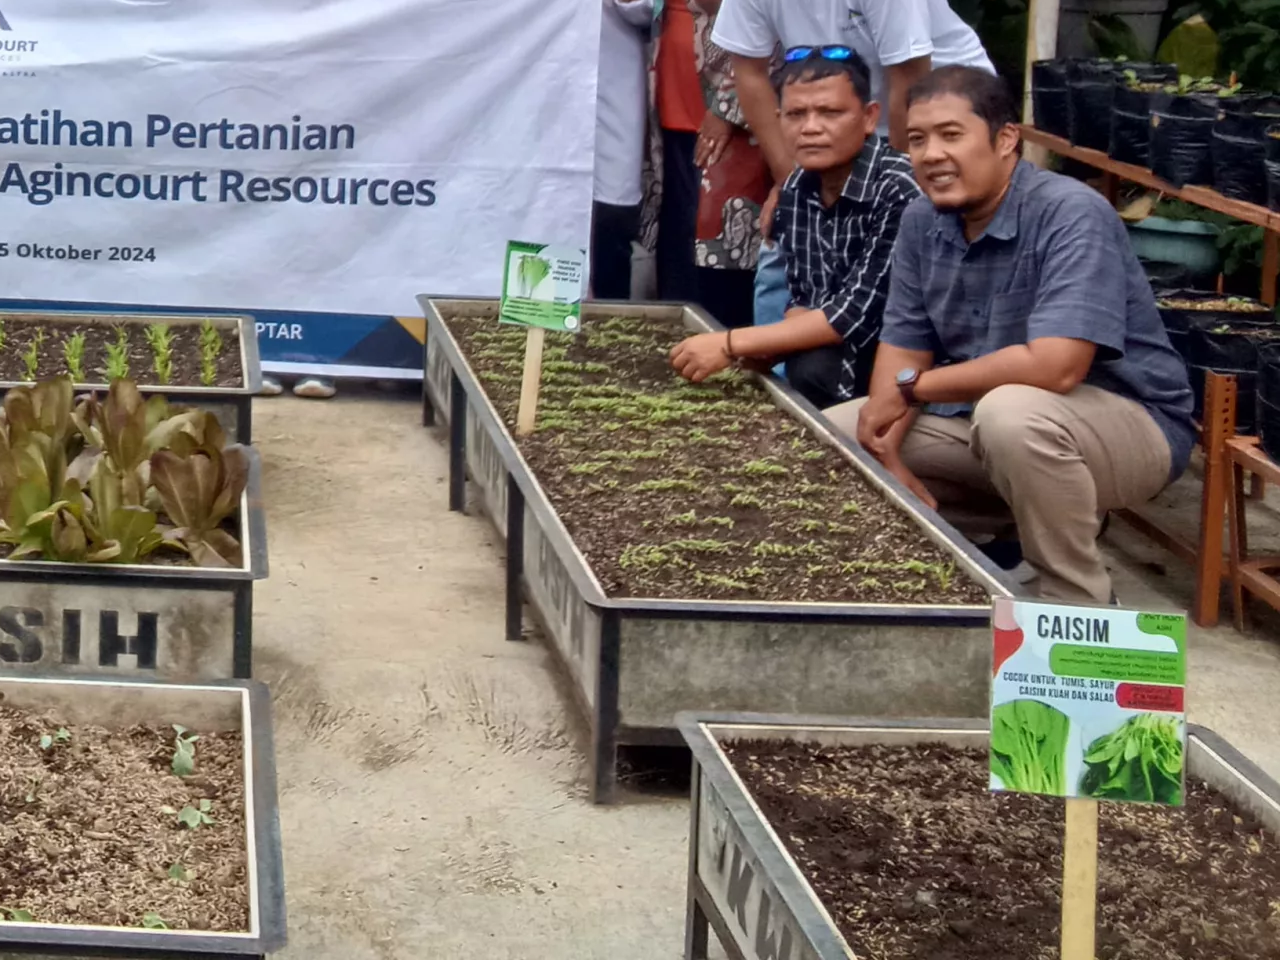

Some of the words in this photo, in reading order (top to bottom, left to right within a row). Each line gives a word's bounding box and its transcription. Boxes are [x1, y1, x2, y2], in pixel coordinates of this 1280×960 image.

[146, 114, 355, 151] Pertanian
[219, 169, 436, 207] Resources
[16, 243, 102, 261] Oktober
[108, 246, 156, 262] 2024
[1037, 614, 1110, 643] CAISIM
[1003, 671, 1029, 683] COCOK
[1031, 674, 1056, 686] UNTUK
[1061, 677, 1087, 689] TUMIS,
[1089, 679, 1115, 690] SAYUR
[1019, 686, 1047, 697] CAISIM
[1048, 688, 1070, 699] KUAH
[1071, 689, 1087, 700] DAN
[1089, 691, 1115, 703] SALAD
